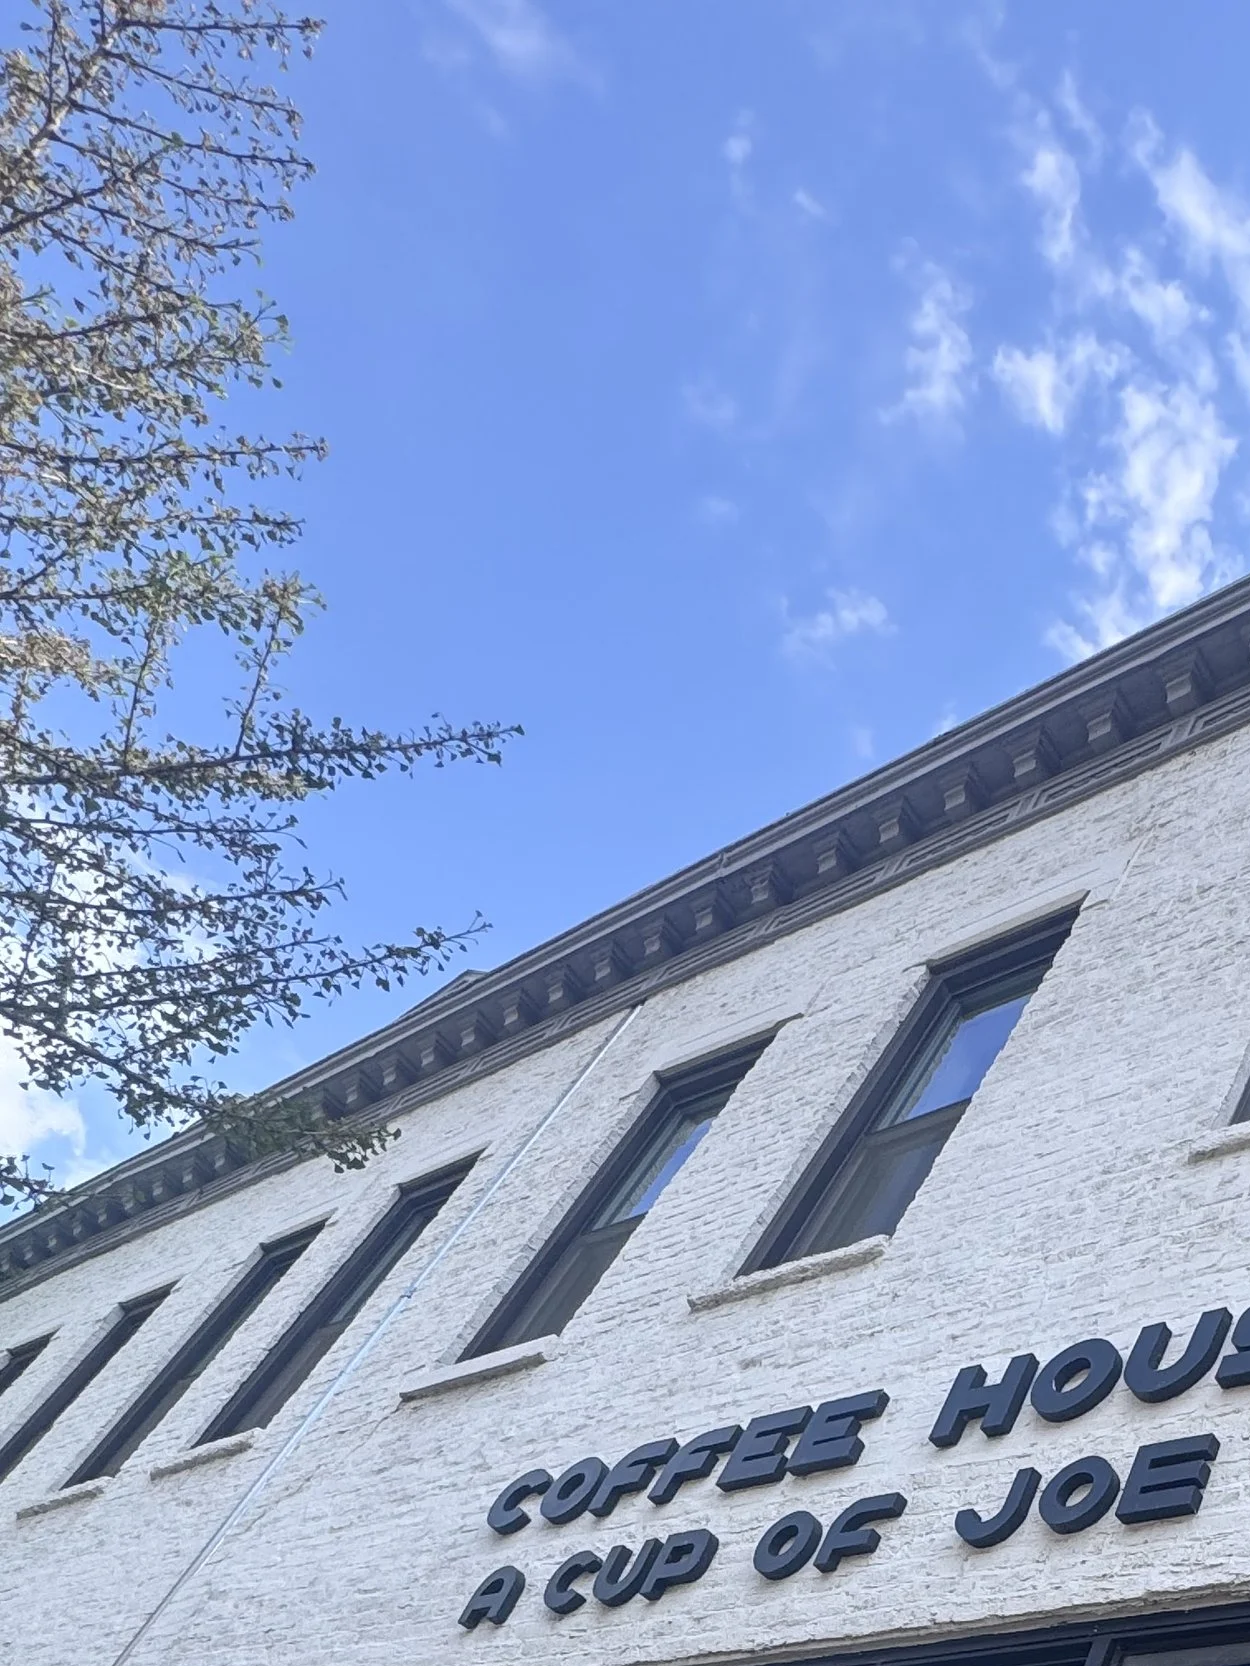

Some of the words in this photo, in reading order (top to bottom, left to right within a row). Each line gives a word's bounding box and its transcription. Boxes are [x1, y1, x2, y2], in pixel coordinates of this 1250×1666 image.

[458, 1566, 526, 1630] A
[544, 1529, 719, 1615] CUP
[753, 1492, 907, 1581] OF
[955, 1433, 1220, 1549] JOE
[487, 1389, 890, 1535] COFFEE
